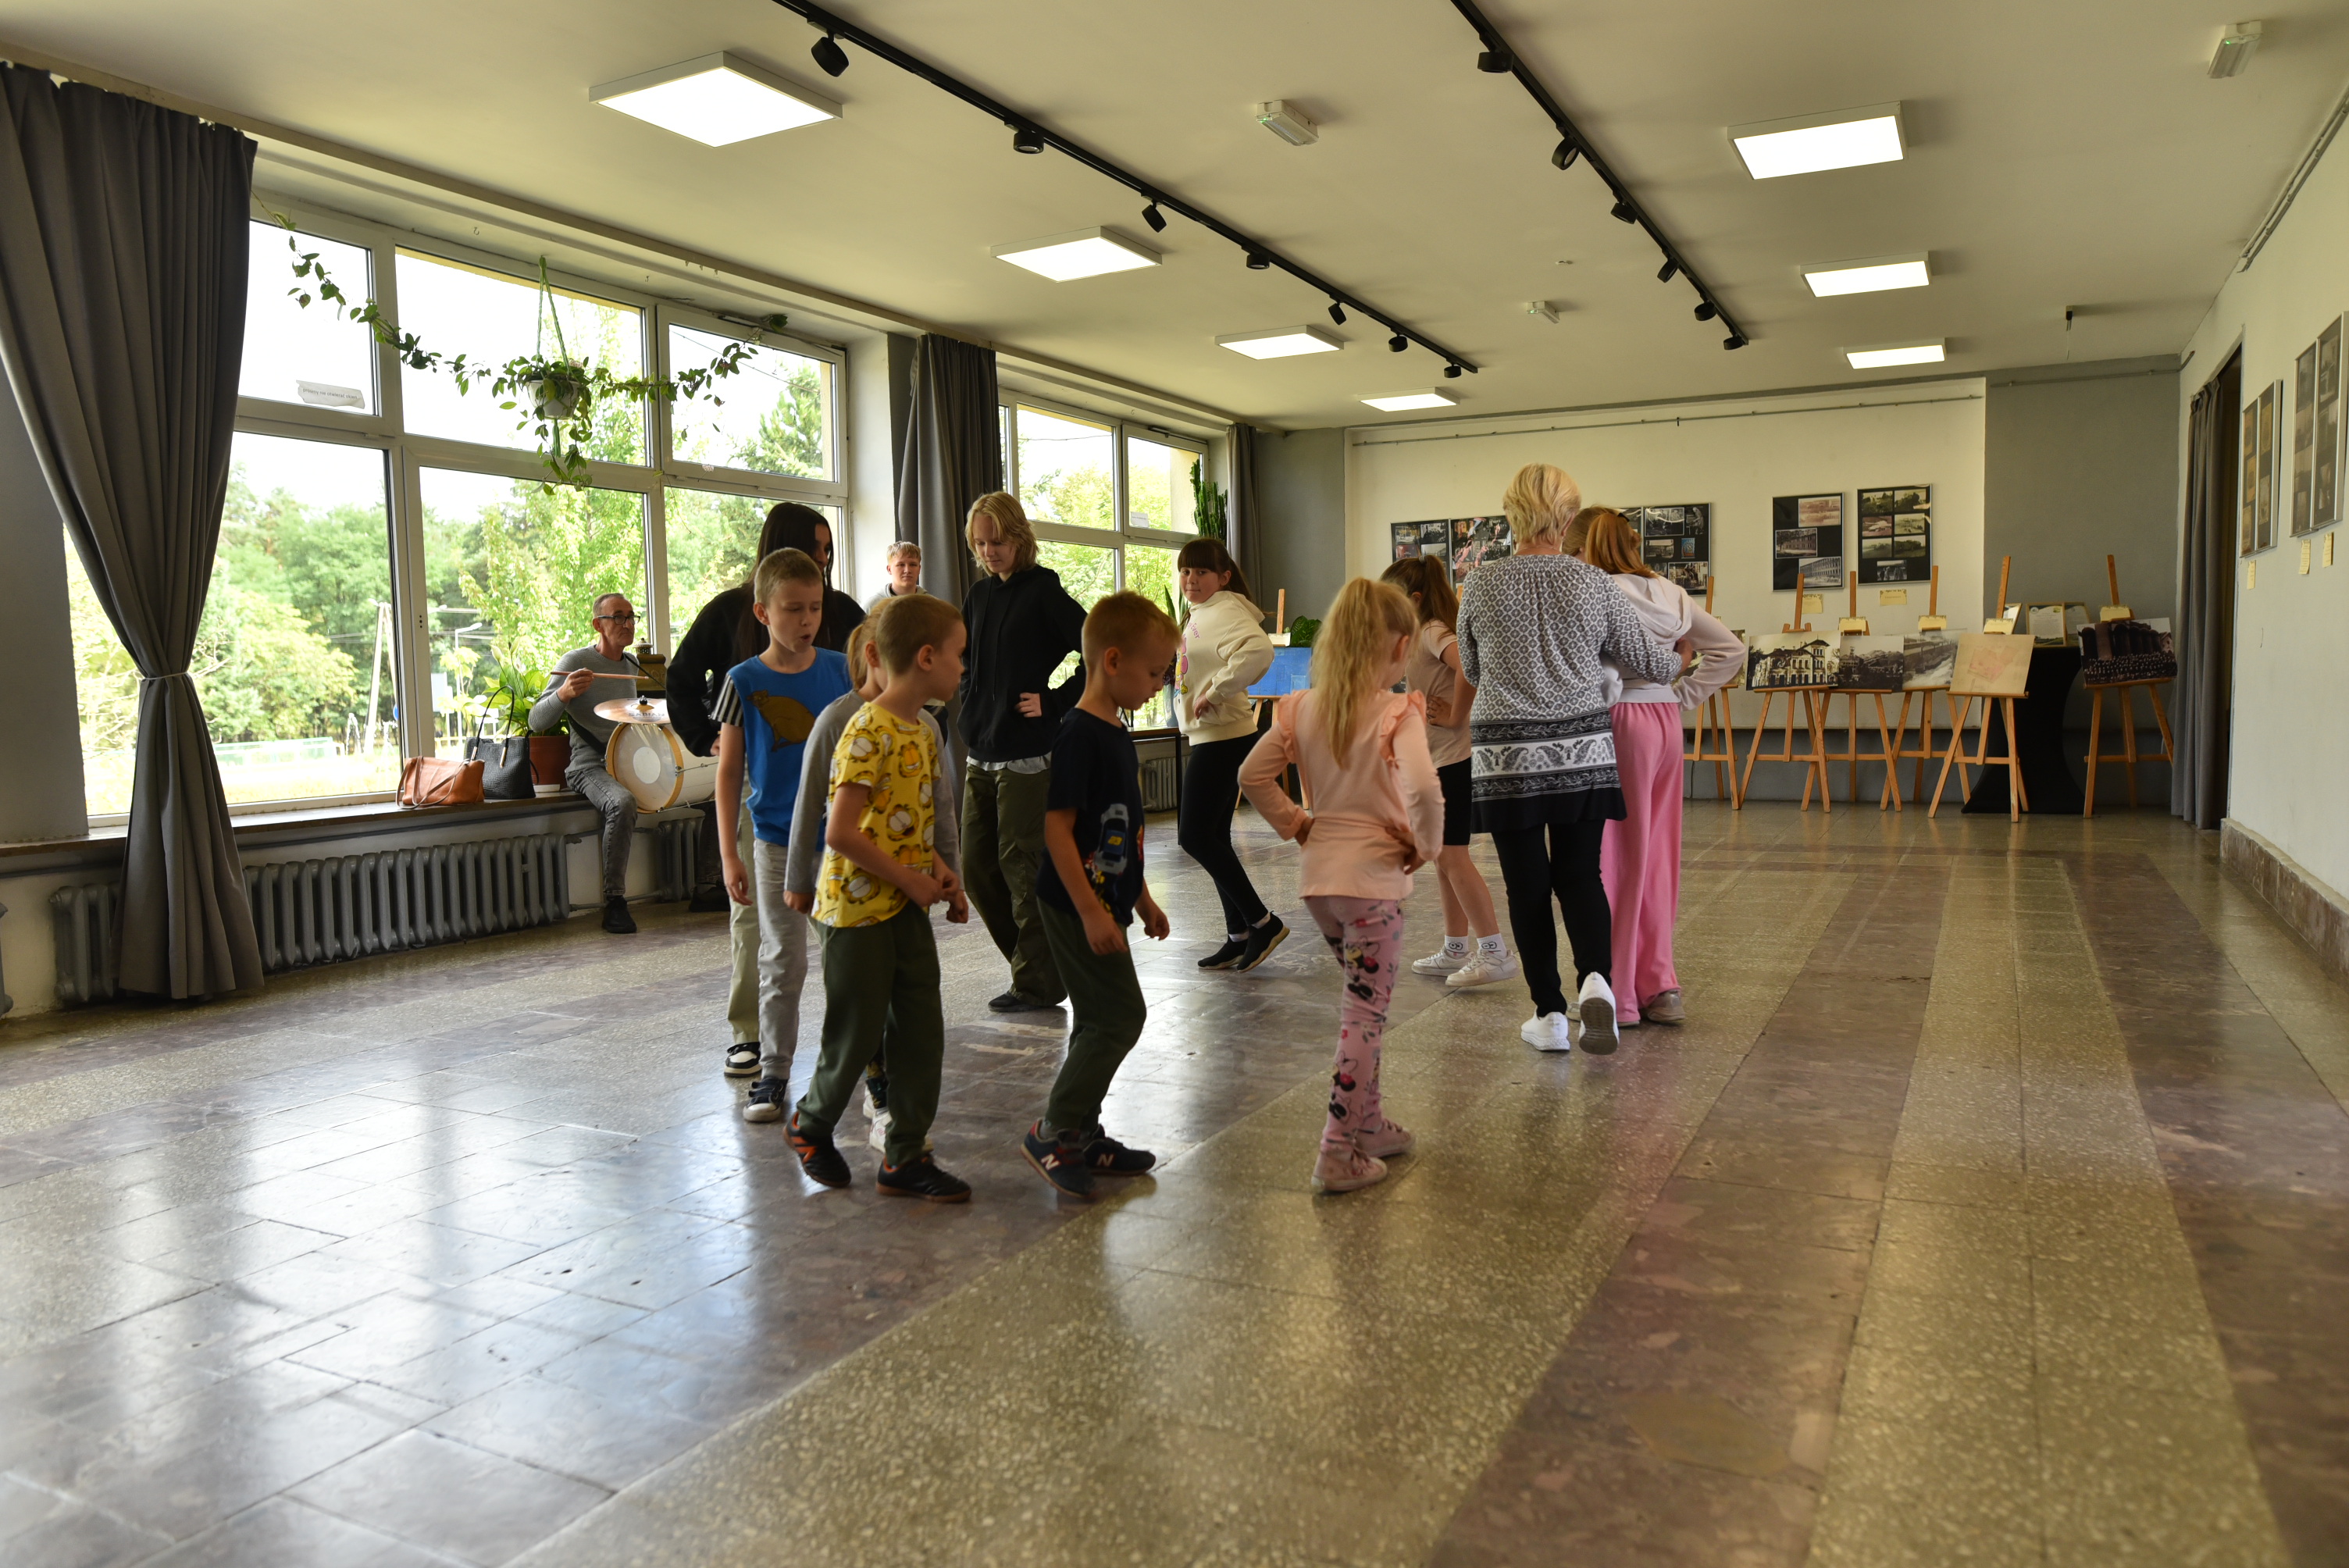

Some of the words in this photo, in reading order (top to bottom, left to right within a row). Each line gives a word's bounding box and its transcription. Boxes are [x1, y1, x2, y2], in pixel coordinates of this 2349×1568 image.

[1191, 622, 1199, 639] Ever
[1041, 1153, 1060, 1171] N
[1096, 1153, 1114, 1167] N
